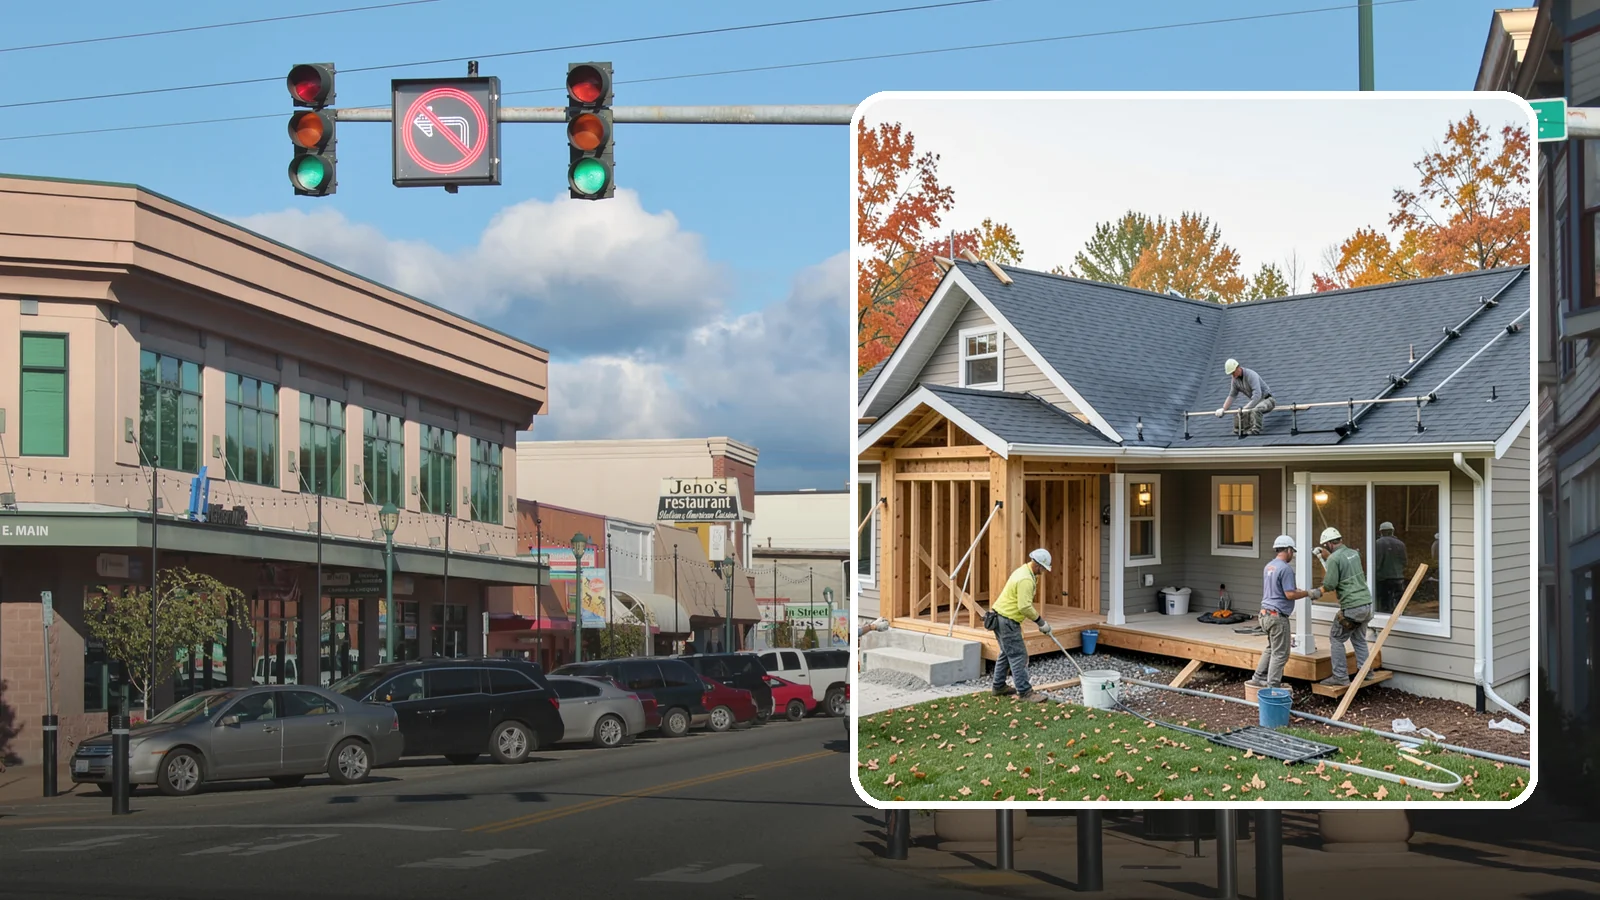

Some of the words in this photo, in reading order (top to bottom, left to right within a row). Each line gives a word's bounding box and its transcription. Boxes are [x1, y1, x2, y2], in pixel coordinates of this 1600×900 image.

[669, 479, 728, 495] Jeno's
[664, 496, 731, 509] restaurant
[658, 509, 681, 520] Italian
[686, 509, 714, 519] American
[715, 509, 737, 519] Cuisine
[2, 525, 13, 536] E.
[15, 525, 49, 536] MAIN
[797, 607, 829, 617] Street
